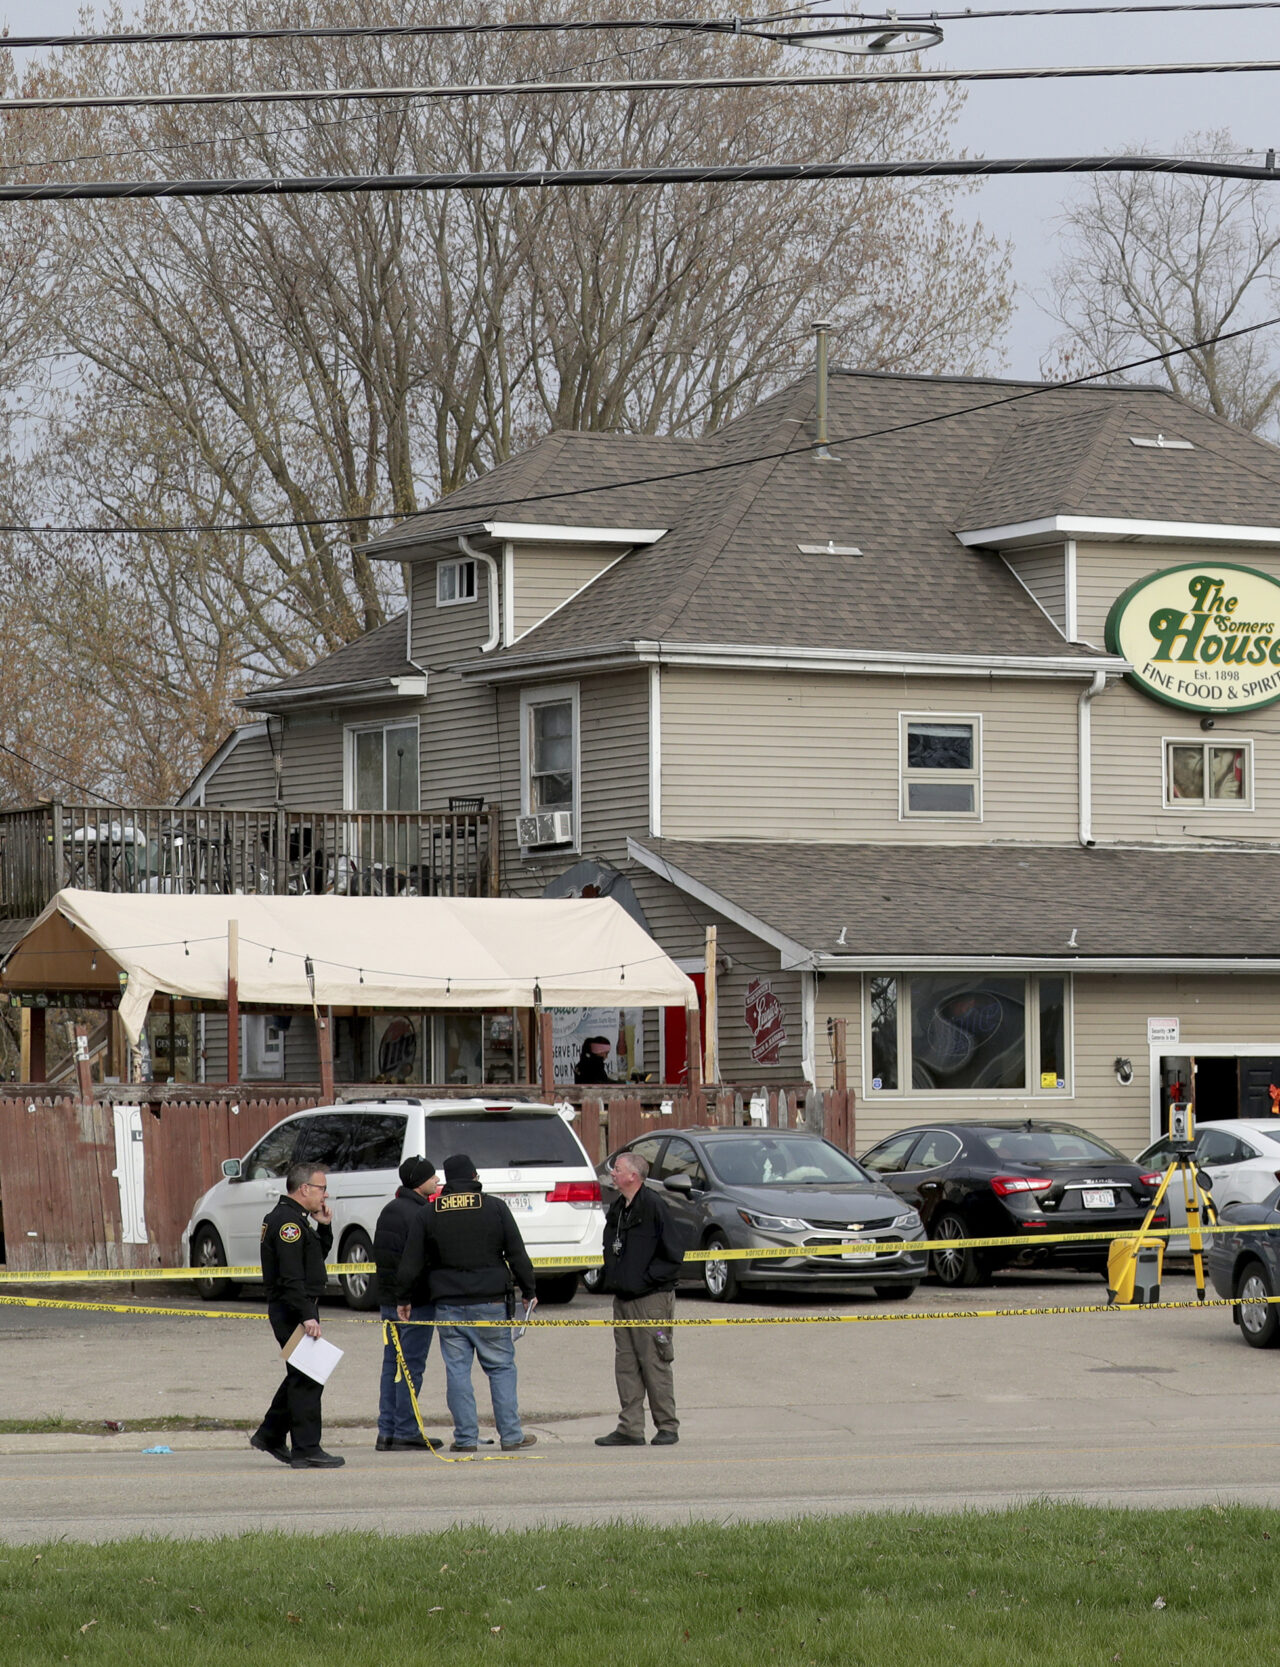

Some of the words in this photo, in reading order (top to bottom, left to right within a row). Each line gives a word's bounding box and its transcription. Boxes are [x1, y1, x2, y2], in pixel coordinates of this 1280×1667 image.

[1188, 575, 1239, 614] The
[1214, 614, 1275, 634] Somers
[1142, 662, 1175, 690] FINE
[1177, 680, 1222, 700] FOOD
[1227, 686, 1238, 700] &
[1194, 669, 1211, 680] Est.
[1215, 670, 1240, 681] 1898
[156, 1038, 187, 1048] GENNE
[440, 1195, 475, 1210] SHERIFF
